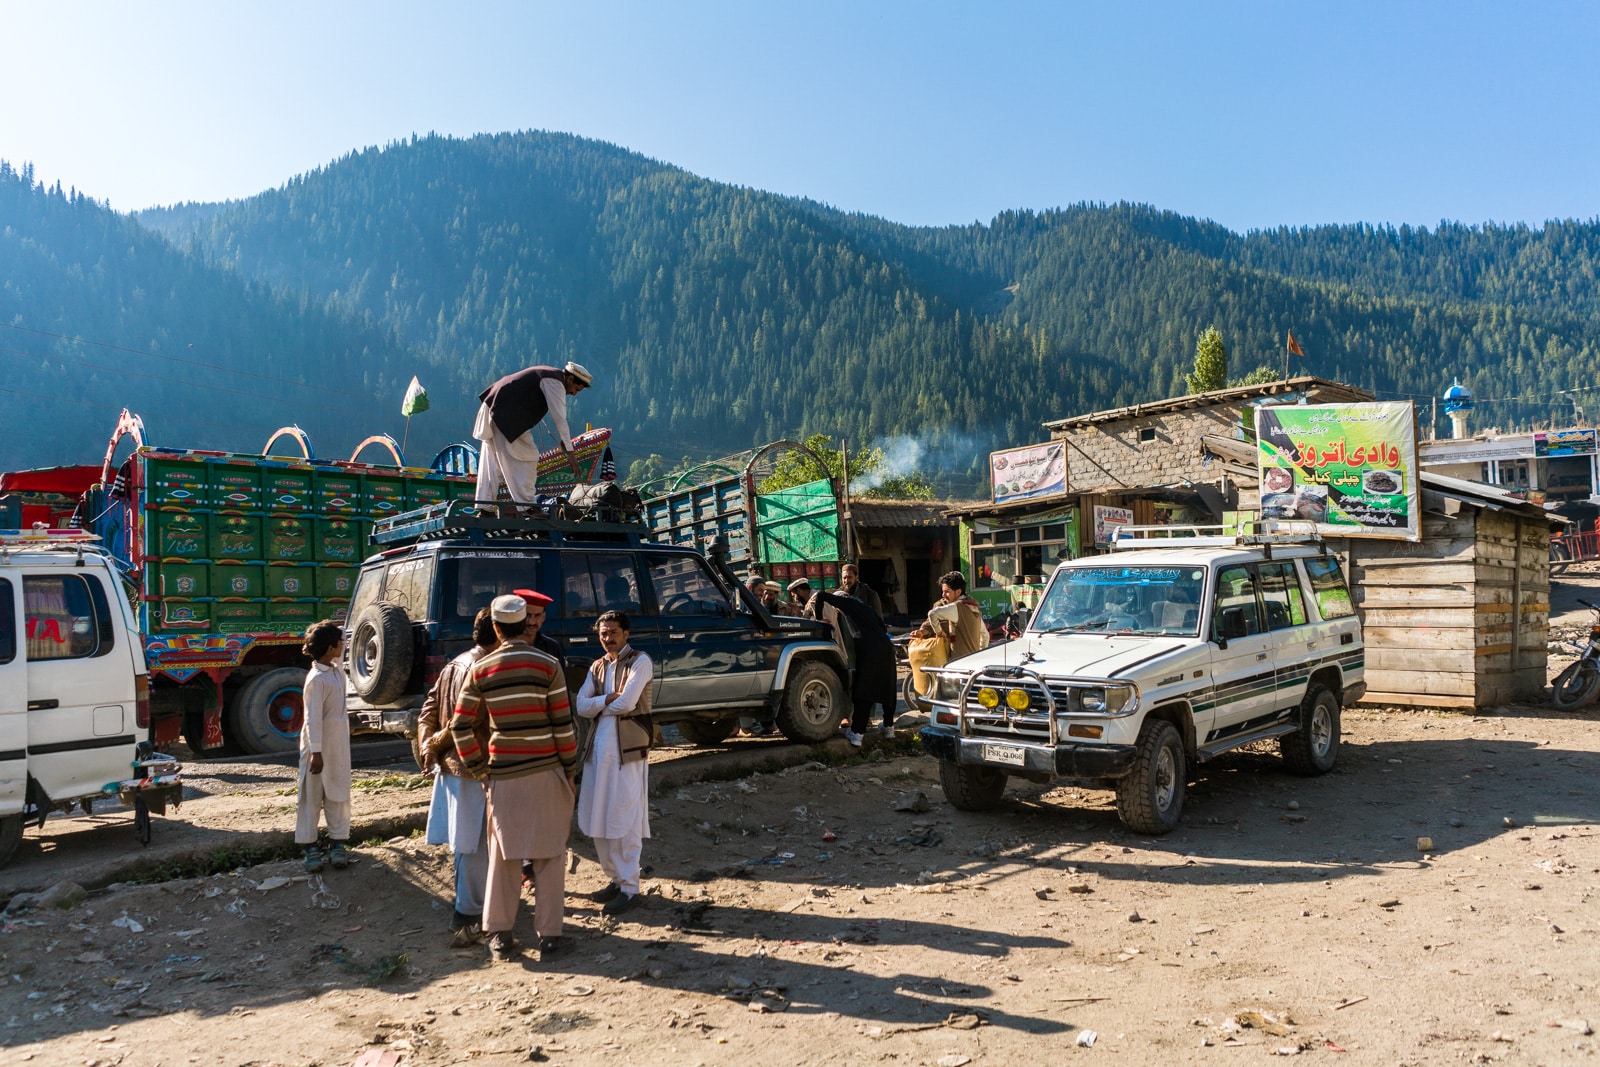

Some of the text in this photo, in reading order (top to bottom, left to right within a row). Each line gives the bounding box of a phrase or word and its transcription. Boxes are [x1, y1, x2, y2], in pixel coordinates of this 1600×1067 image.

[1347, 441, 1400, 468] وادی
[1303, 469, 1360, 487] چپلی کباب
